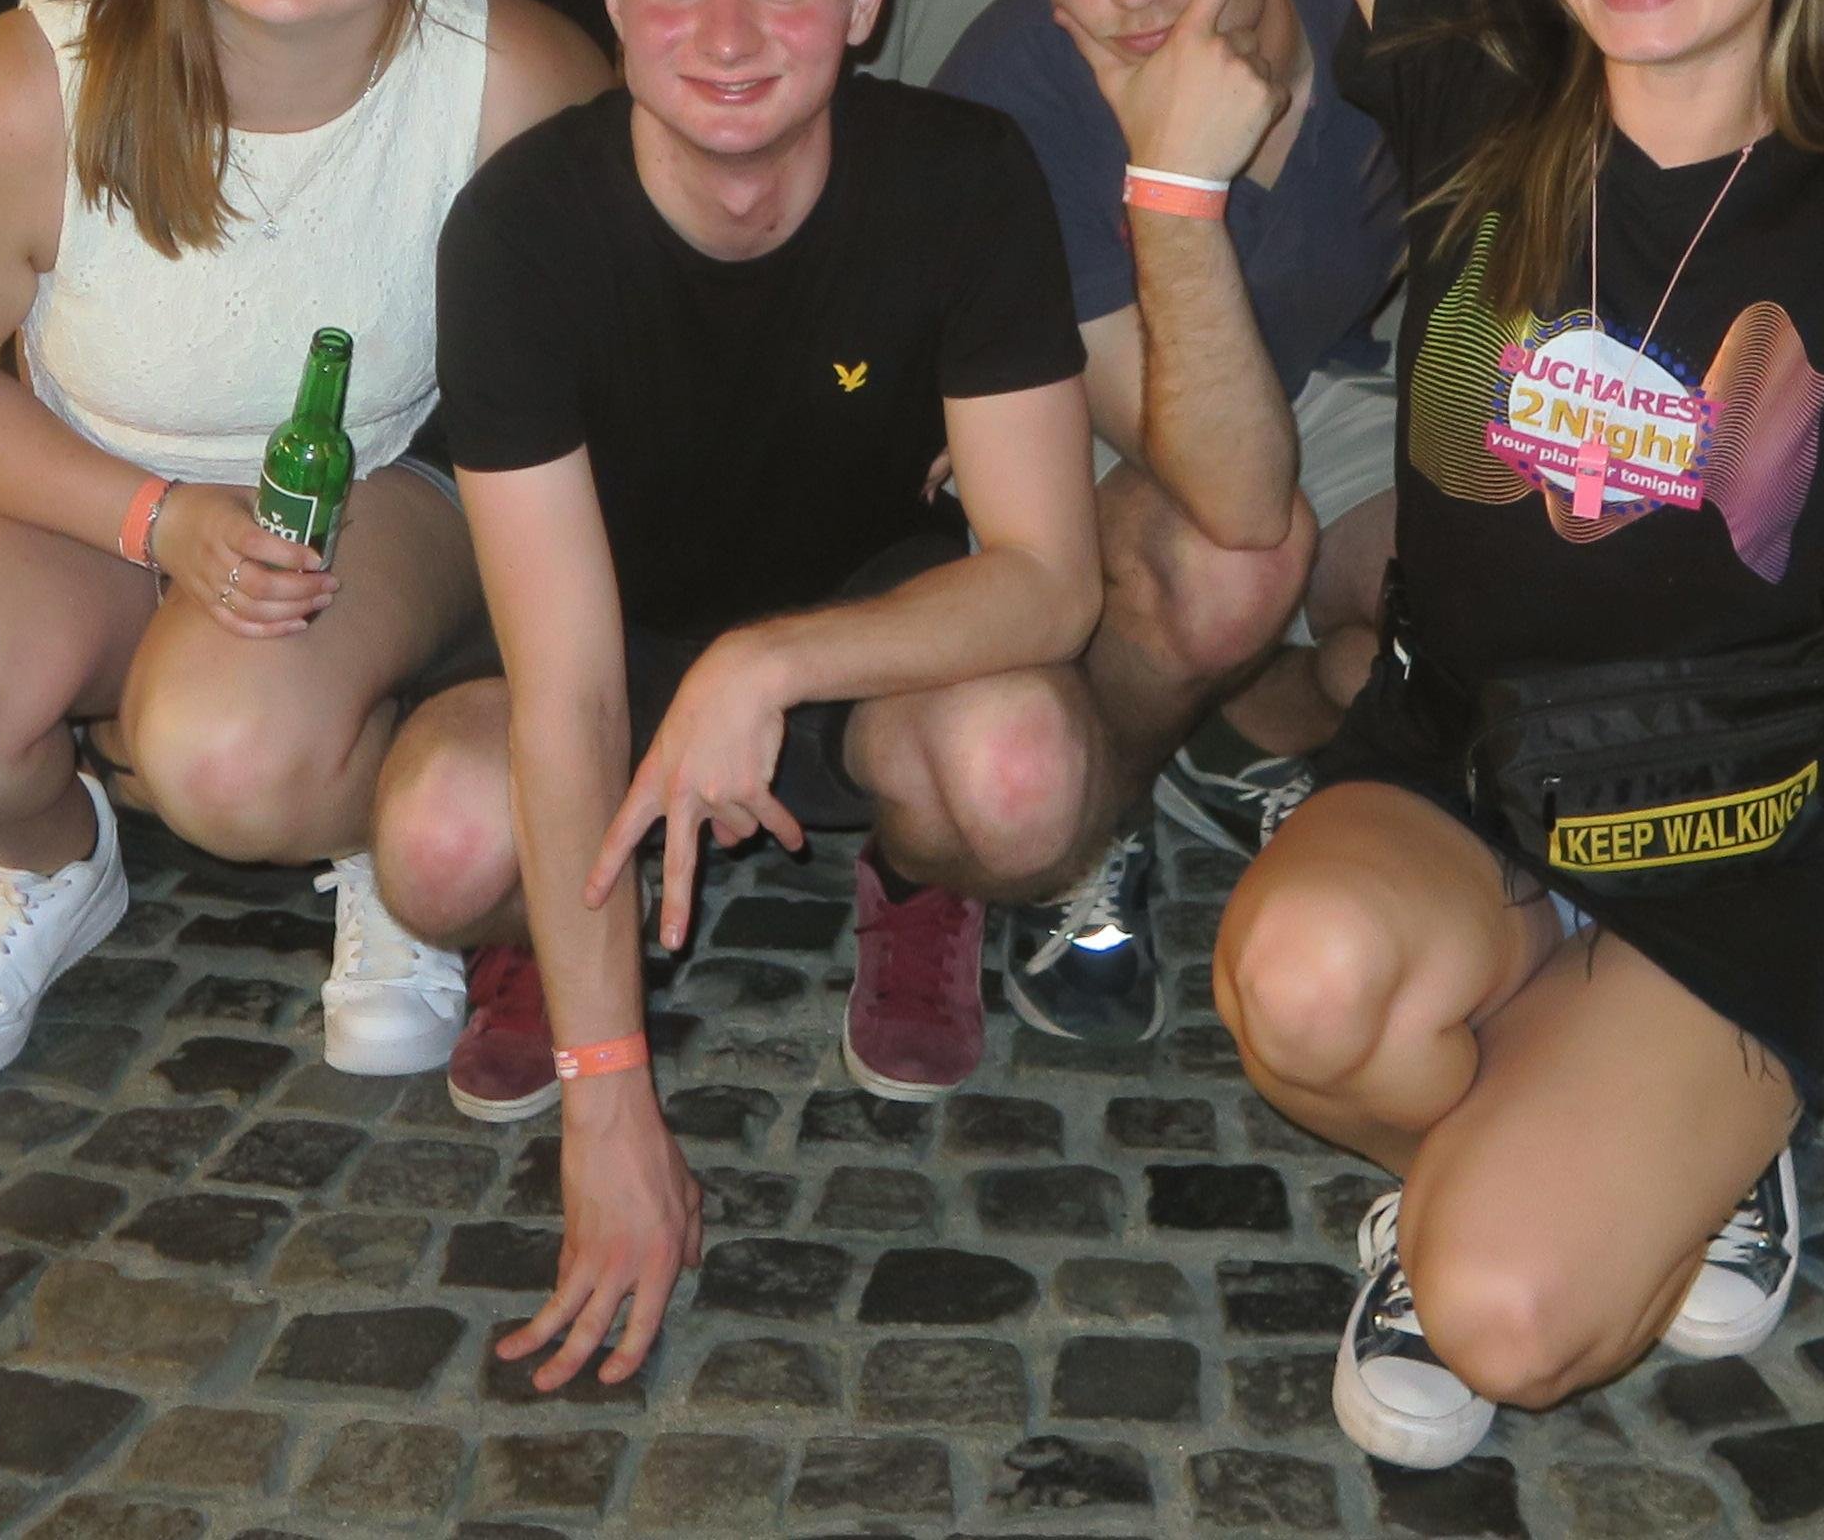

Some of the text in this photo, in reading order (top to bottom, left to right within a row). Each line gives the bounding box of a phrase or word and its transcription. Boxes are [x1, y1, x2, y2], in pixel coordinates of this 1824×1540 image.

[1490, 431, 1536, 456] your
[1619, 465, 1698, 501] tonight!
[1566, 783, 1804, 865] KEEP WALKING
